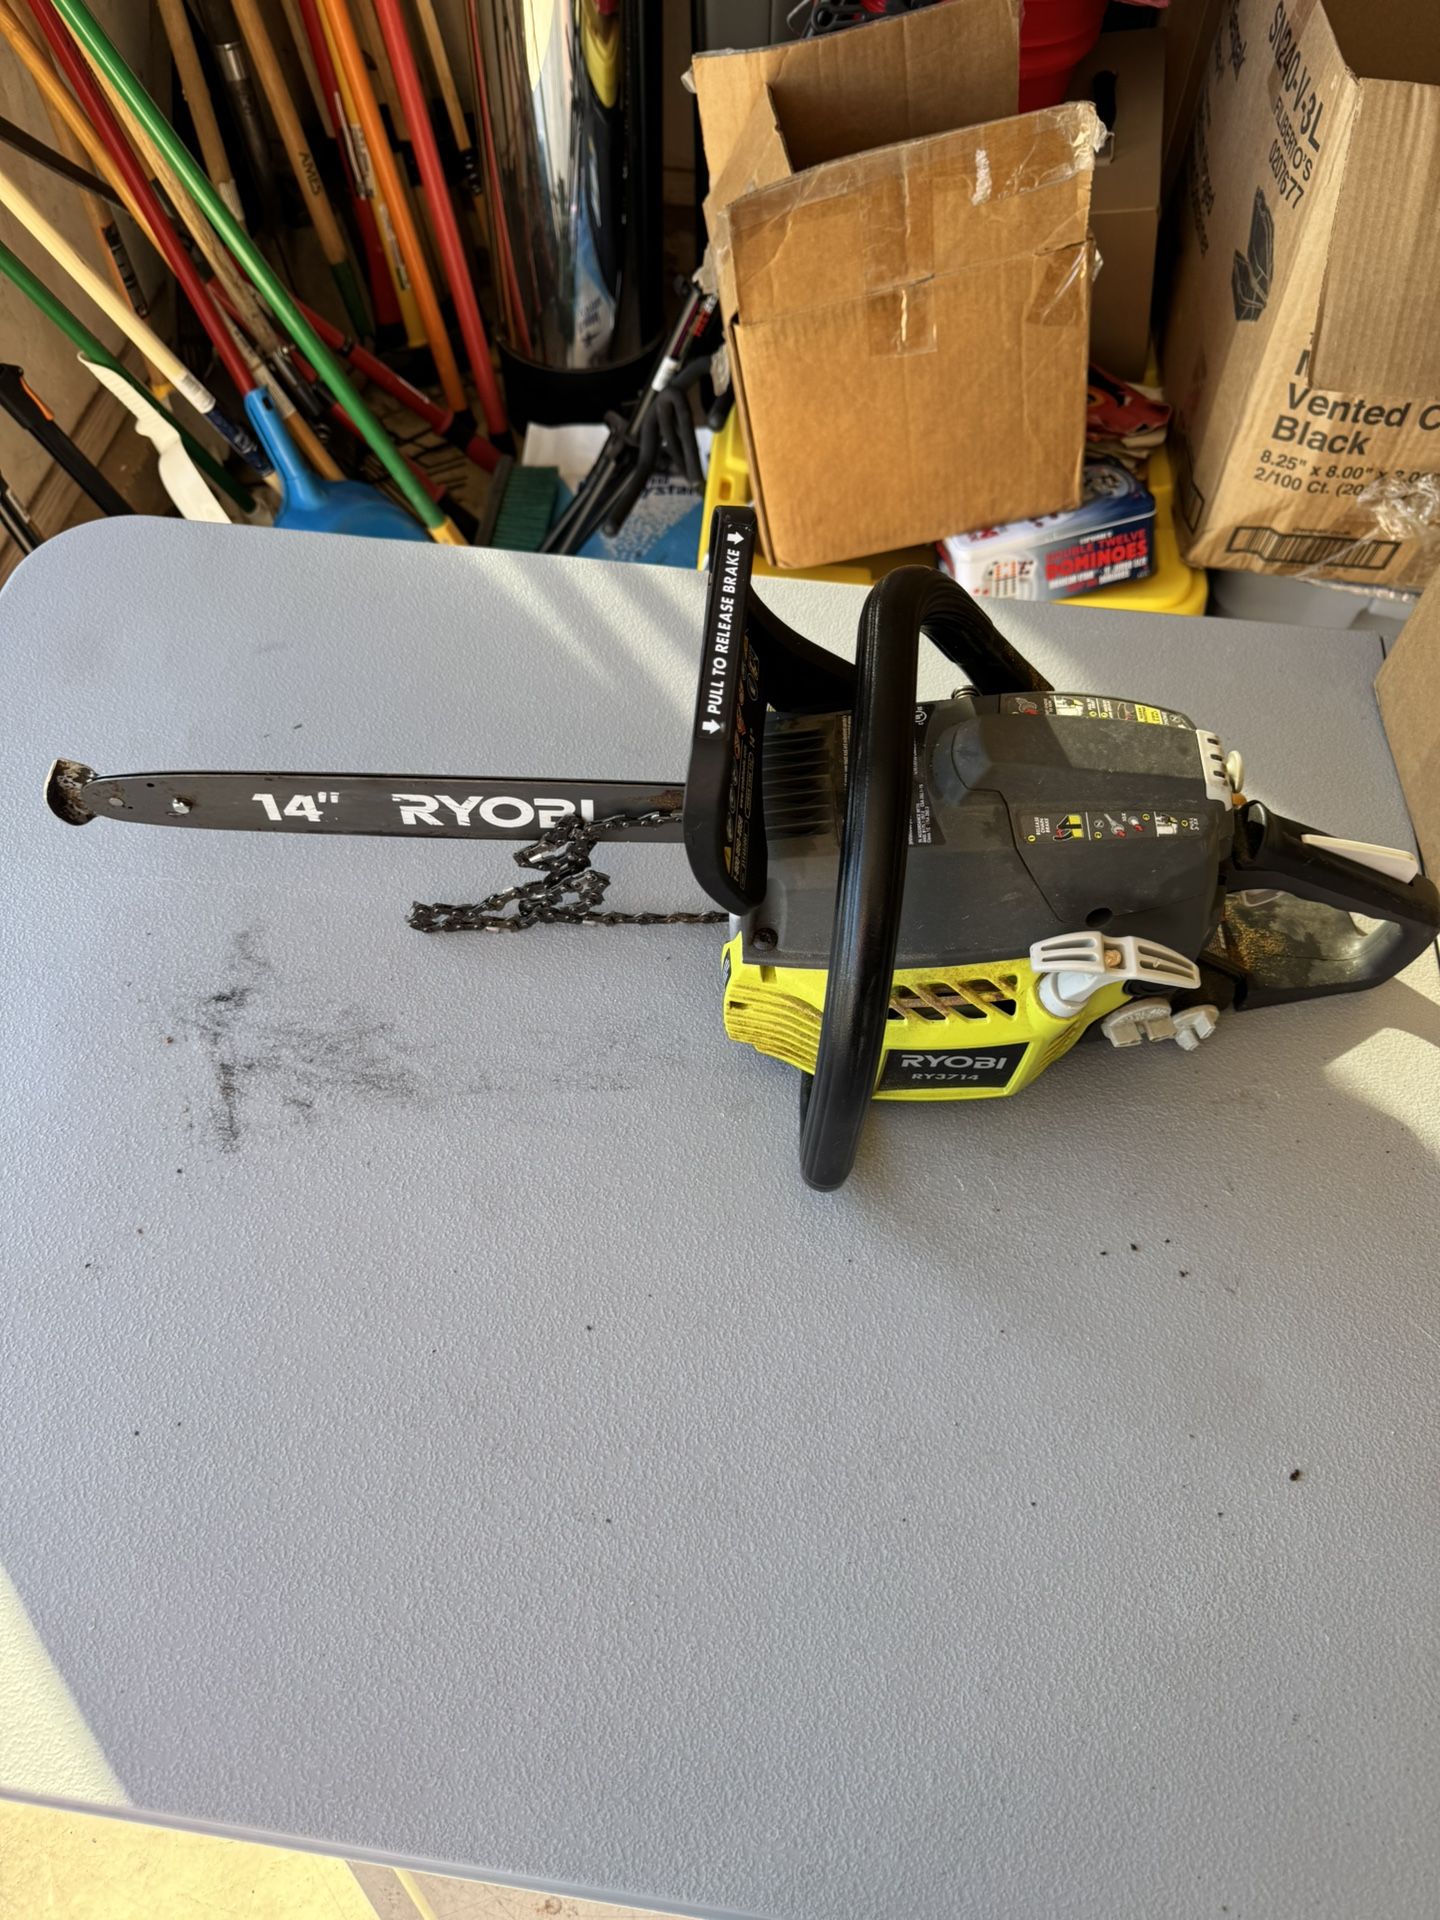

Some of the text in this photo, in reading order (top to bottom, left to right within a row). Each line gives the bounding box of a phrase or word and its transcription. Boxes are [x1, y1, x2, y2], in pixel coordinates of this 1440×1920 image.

[1268, 1, 1324, 153] SN240-V-3L
[299, 151, 322, 197] AMES
[1288, 382, 1412, 427] Vented
[1271, 414, 1371, 456] Black
[1254, 467, 1365, 498] 2/100 Ct. (20
[1260, 449, 1307, 470] 8.25"
[1310, 465, 1322, 477] x
[1325, 464, 1374, 480] 8.00"
[1098, 528, 1147, 552] TWELVE
[1044, 540, 1148, 581] DOMINOES
[707, 548, 740, 715] PULL TO RELEASE BRAKE
[252, 791, 595, 828] 14" RYOBI
[901, 1054, 1008, 1070] RYOBI
[911, 1073, 980, 1081] RY3714
